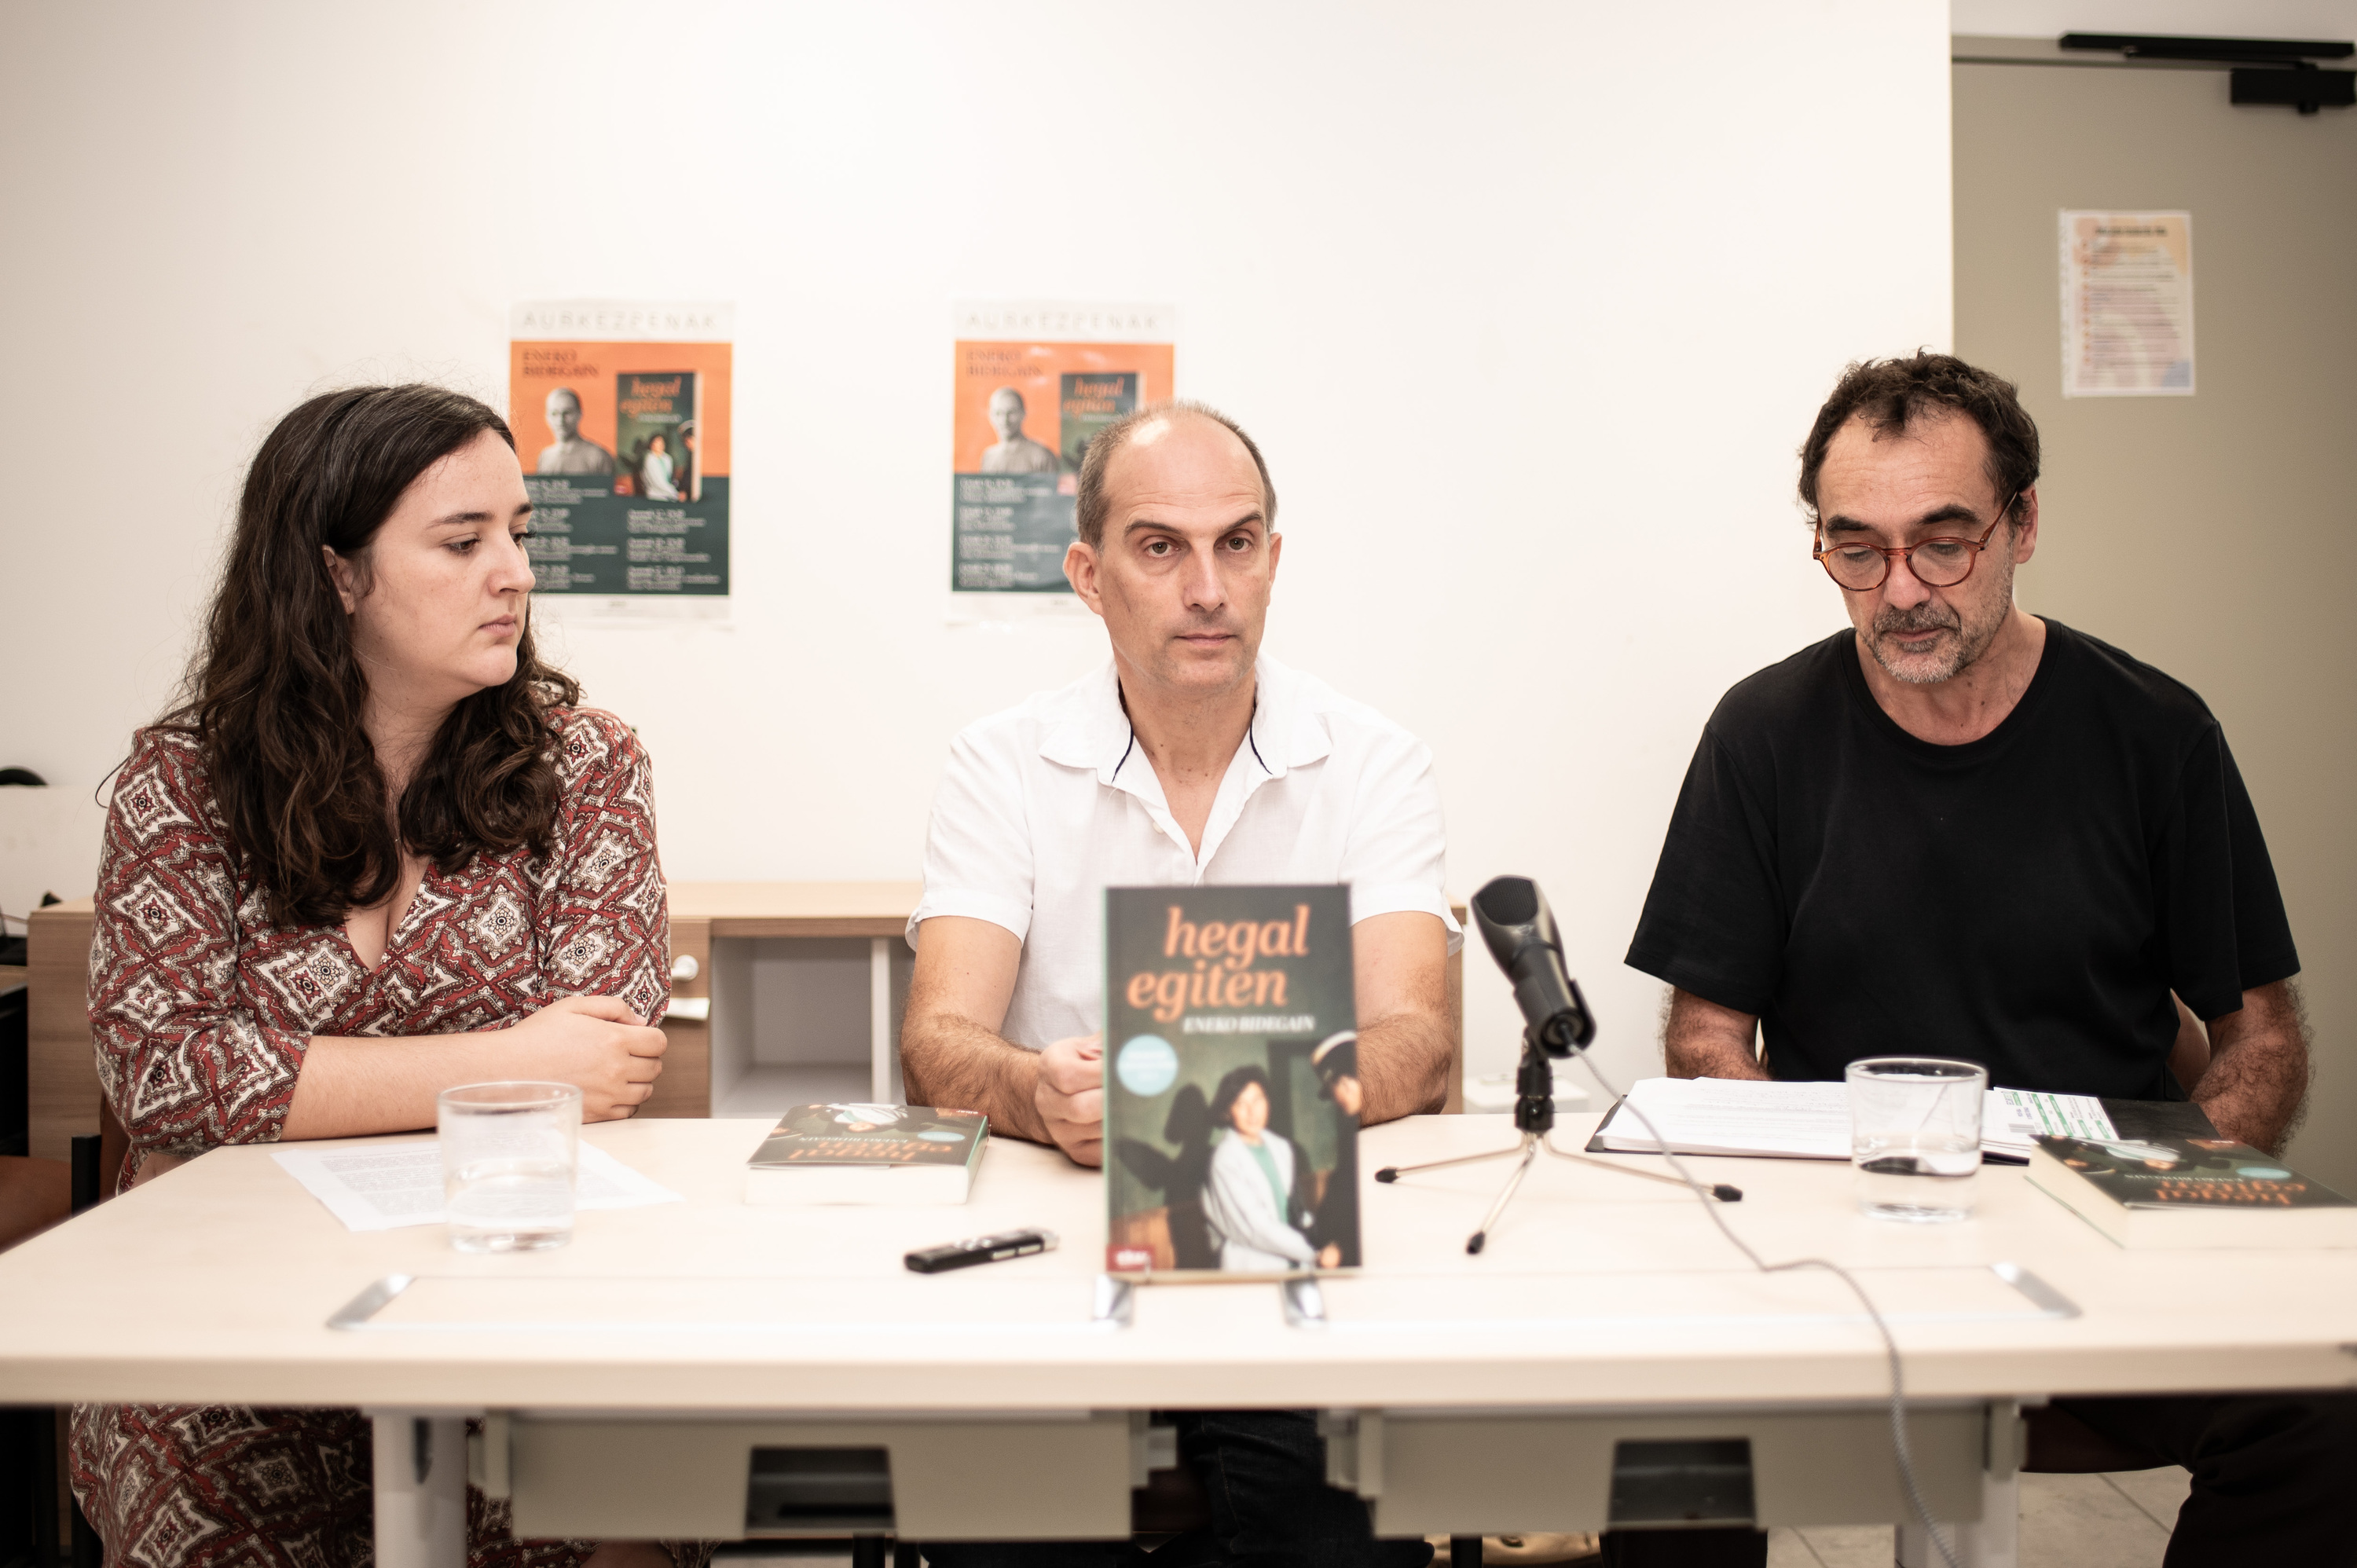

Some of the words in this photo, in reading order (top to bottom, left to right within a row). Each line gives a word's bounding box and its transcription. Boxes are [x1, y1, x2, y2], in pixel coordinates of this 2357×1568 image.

[523, 311, 717, 331] AURKEZPENAK
[966, 311, 1160, 332] AURKEZPENAK
[1164, 903, 1311, 971] hegal
[1126, 959, 1289, 1022] egiten
[1183, 1016, 1237, 1033] ENEKO
[1239, 1015, 1316, 1033] BIDEGAIN
